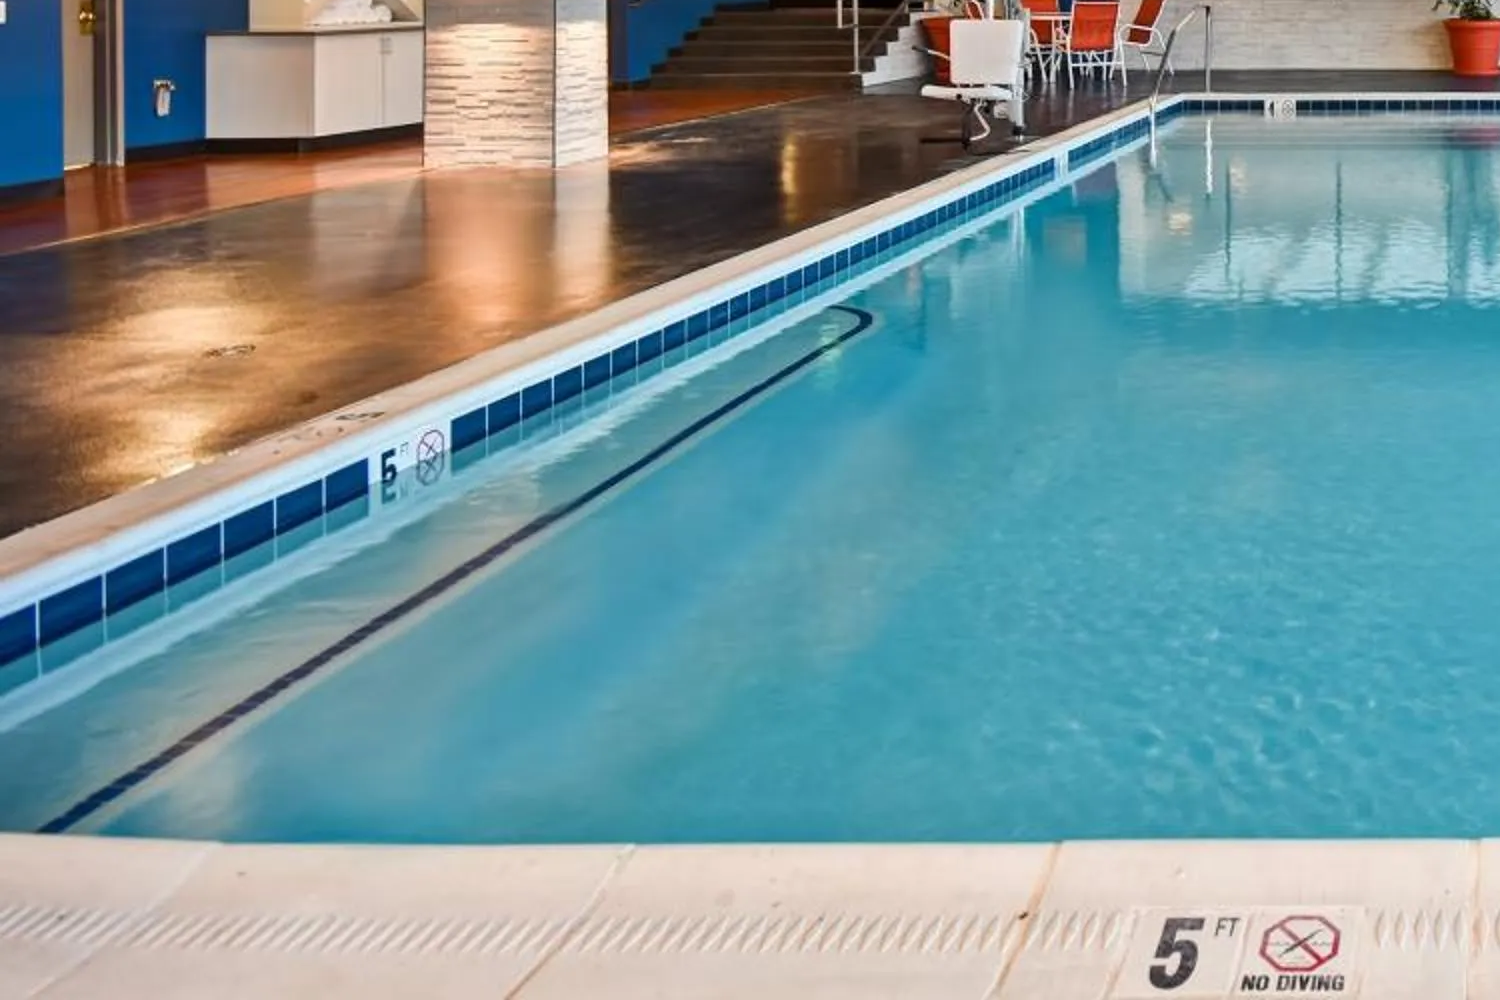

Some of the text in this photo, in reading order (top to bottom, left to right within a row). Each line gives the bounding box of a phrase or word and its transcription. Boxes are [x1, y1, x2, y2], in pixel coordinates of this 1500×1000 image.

[381, 447, 397, 485] 5
[1149, 917, 1241, 990] 5 FT
[1241, 974, 1345, 992] NO DIVING
